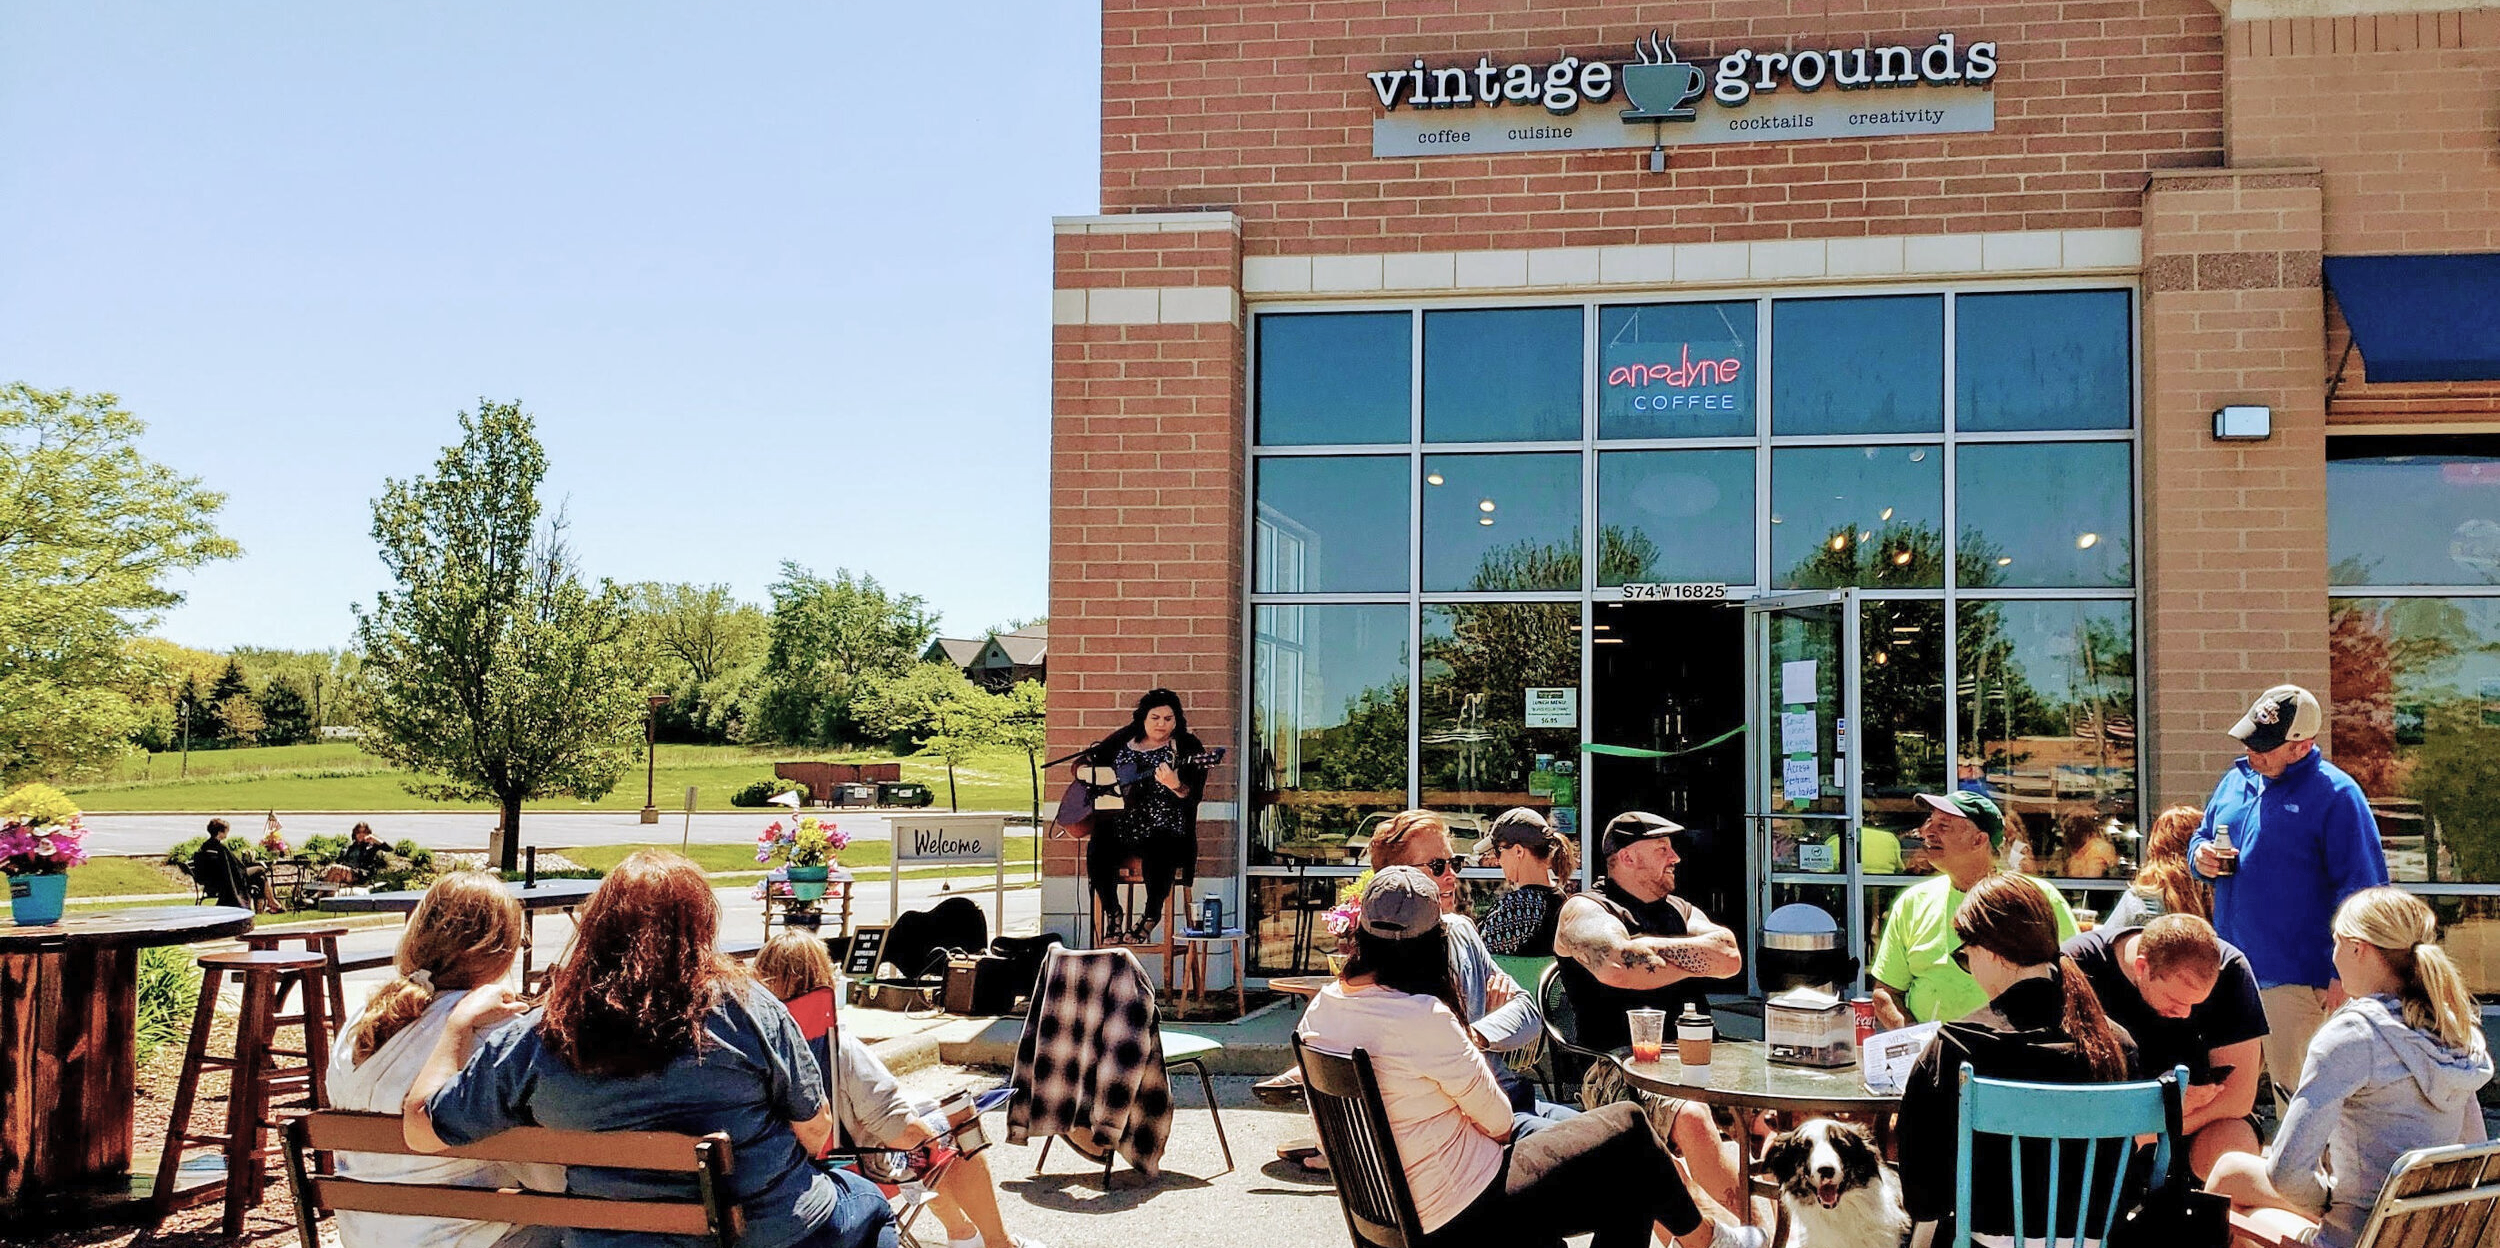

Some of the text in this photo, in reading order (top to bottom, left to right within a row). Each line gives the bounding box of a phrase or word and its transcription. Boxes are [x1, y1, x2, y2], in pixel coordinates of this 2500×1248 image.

[1366, 33, 1998, 111] vintage grounds
[1417, 108, 1945, 145] coffee cuisine cocktails creativity
[1608, 342, 1741, 389] anodyne
[1633, 394, 1735, 411] COFFEE
[914, 828, 982, 856] Welcome
